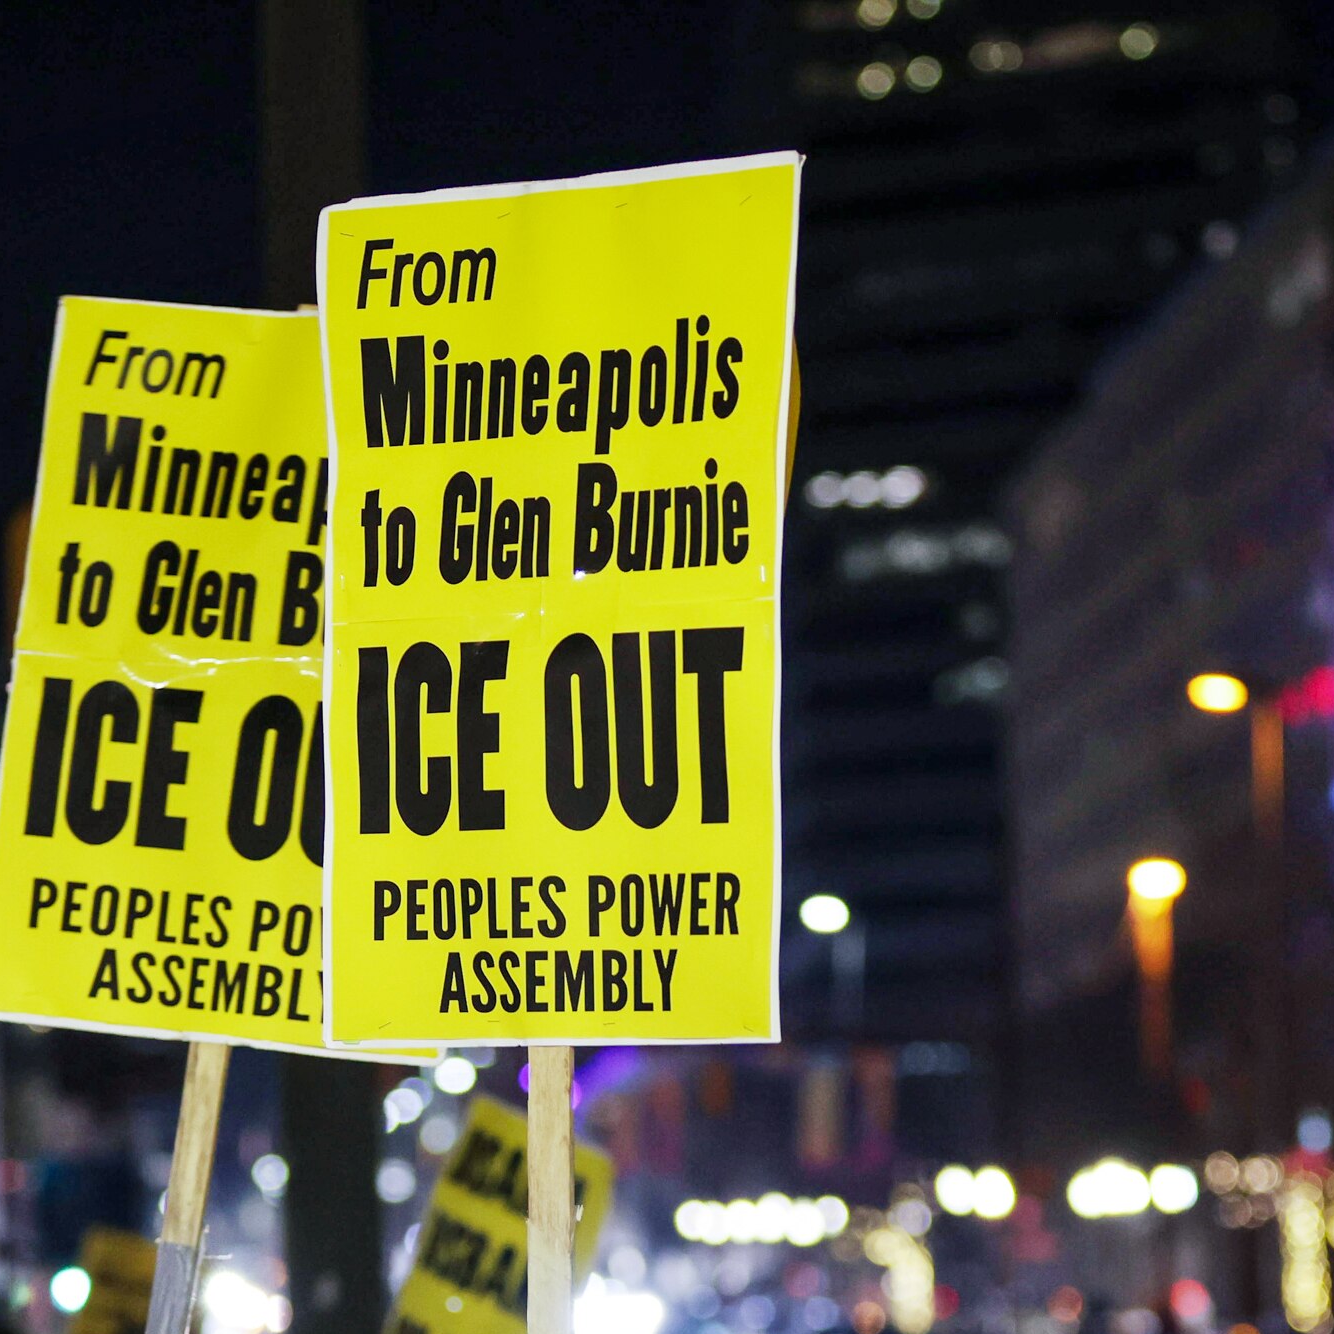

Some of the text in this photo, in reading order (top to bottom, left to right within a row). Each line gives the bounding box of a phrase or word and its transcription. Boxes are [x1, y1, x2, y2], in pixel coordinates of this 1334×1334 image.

[357, 239, 496, 308] From
[84, 330, 226, 399] From
[360, 314, 744, 455] Minneapolis
[361, 457, 749, 587] to Glen Burnie
[56, 540, 325, 647] to Glen B
[23, 676, 205, 851] ICE
[356, 626, 745, 836] ICE OUT
[28, 877, 324, 957] PEOPLES PO
[373, 872, 741, 941] PEOPLES POWER
[88, 948, 324, 1025] ASSEMBL
[439, 949, 678, 1014] ASSEMBLY
